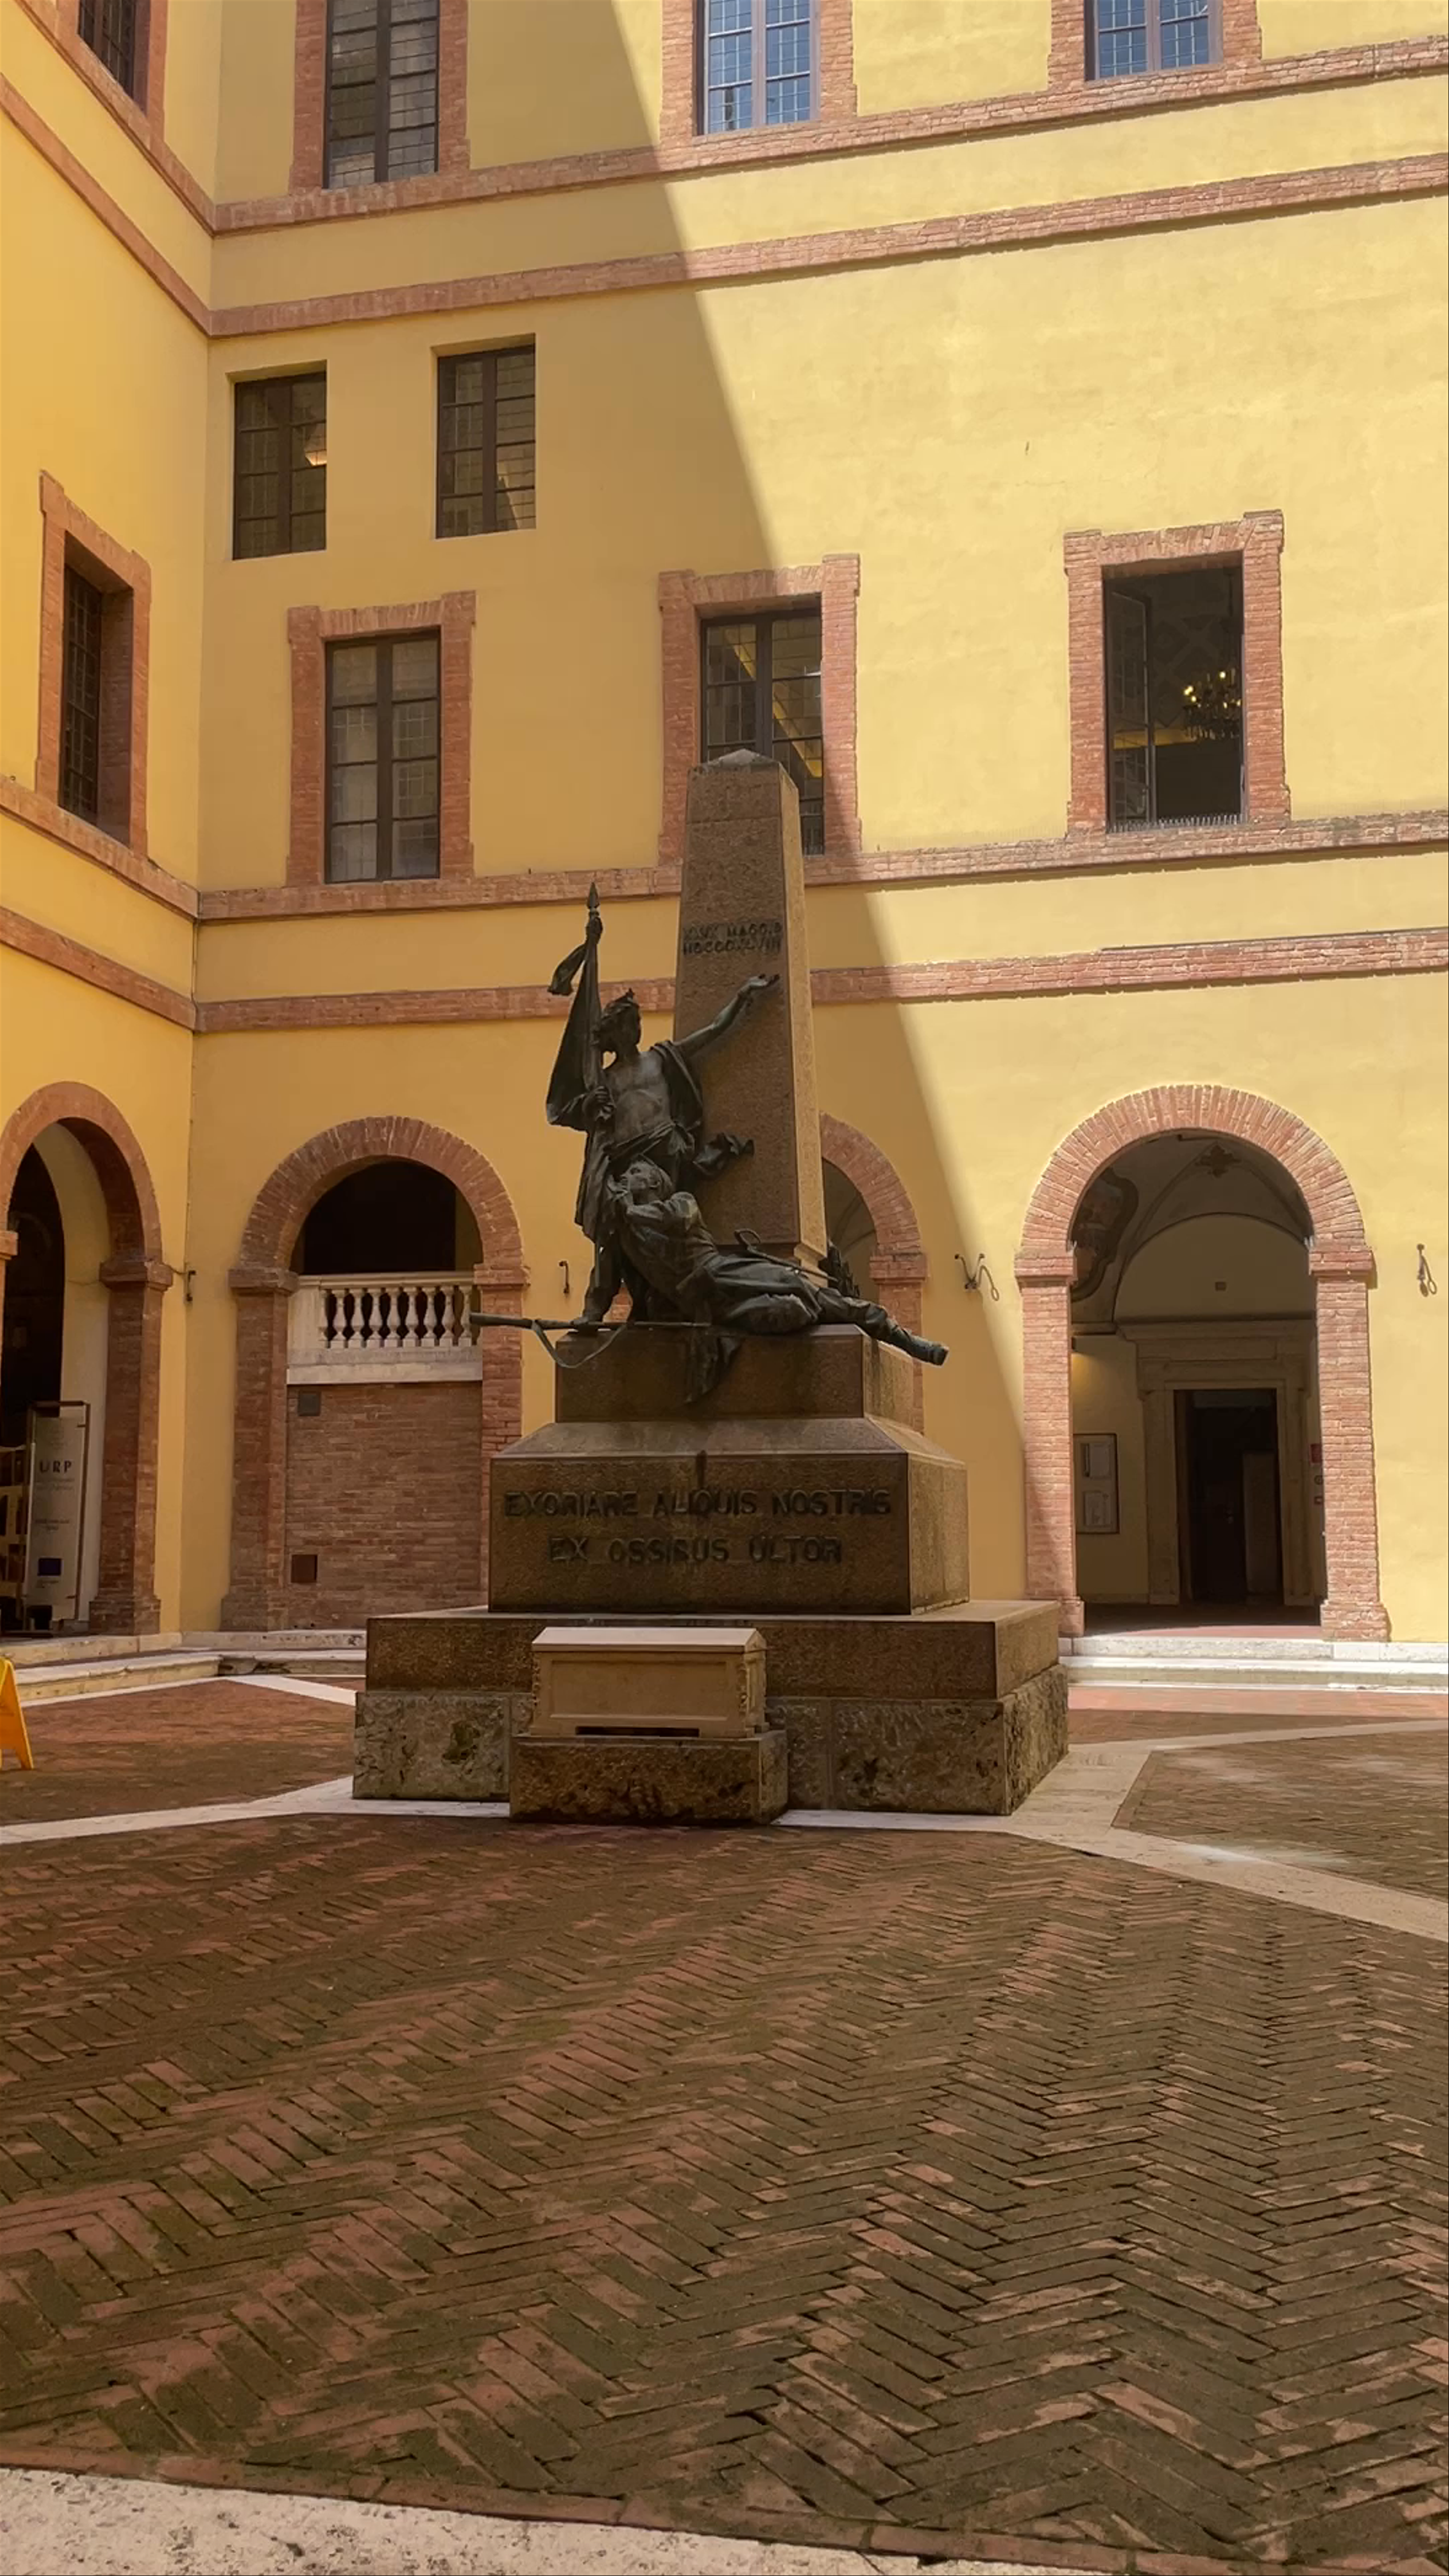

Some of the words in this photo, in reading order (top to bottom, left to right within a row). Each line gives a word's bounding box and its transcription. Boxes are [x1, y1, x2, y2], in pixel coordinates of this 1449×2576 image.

[39, 1460, 72, 1474] URP
[504, 1492, 639, 1517] EXORIARE
[653, 1490, 756, 1517] ALIQUIS
[772, 1490, 891, 1515] NOSTRIS
[547, 1538, 588, 1562] EX
[608, 1537, 729, 1562] OSSIBUS
[749, 1536, 841, 1562] ULTOR
